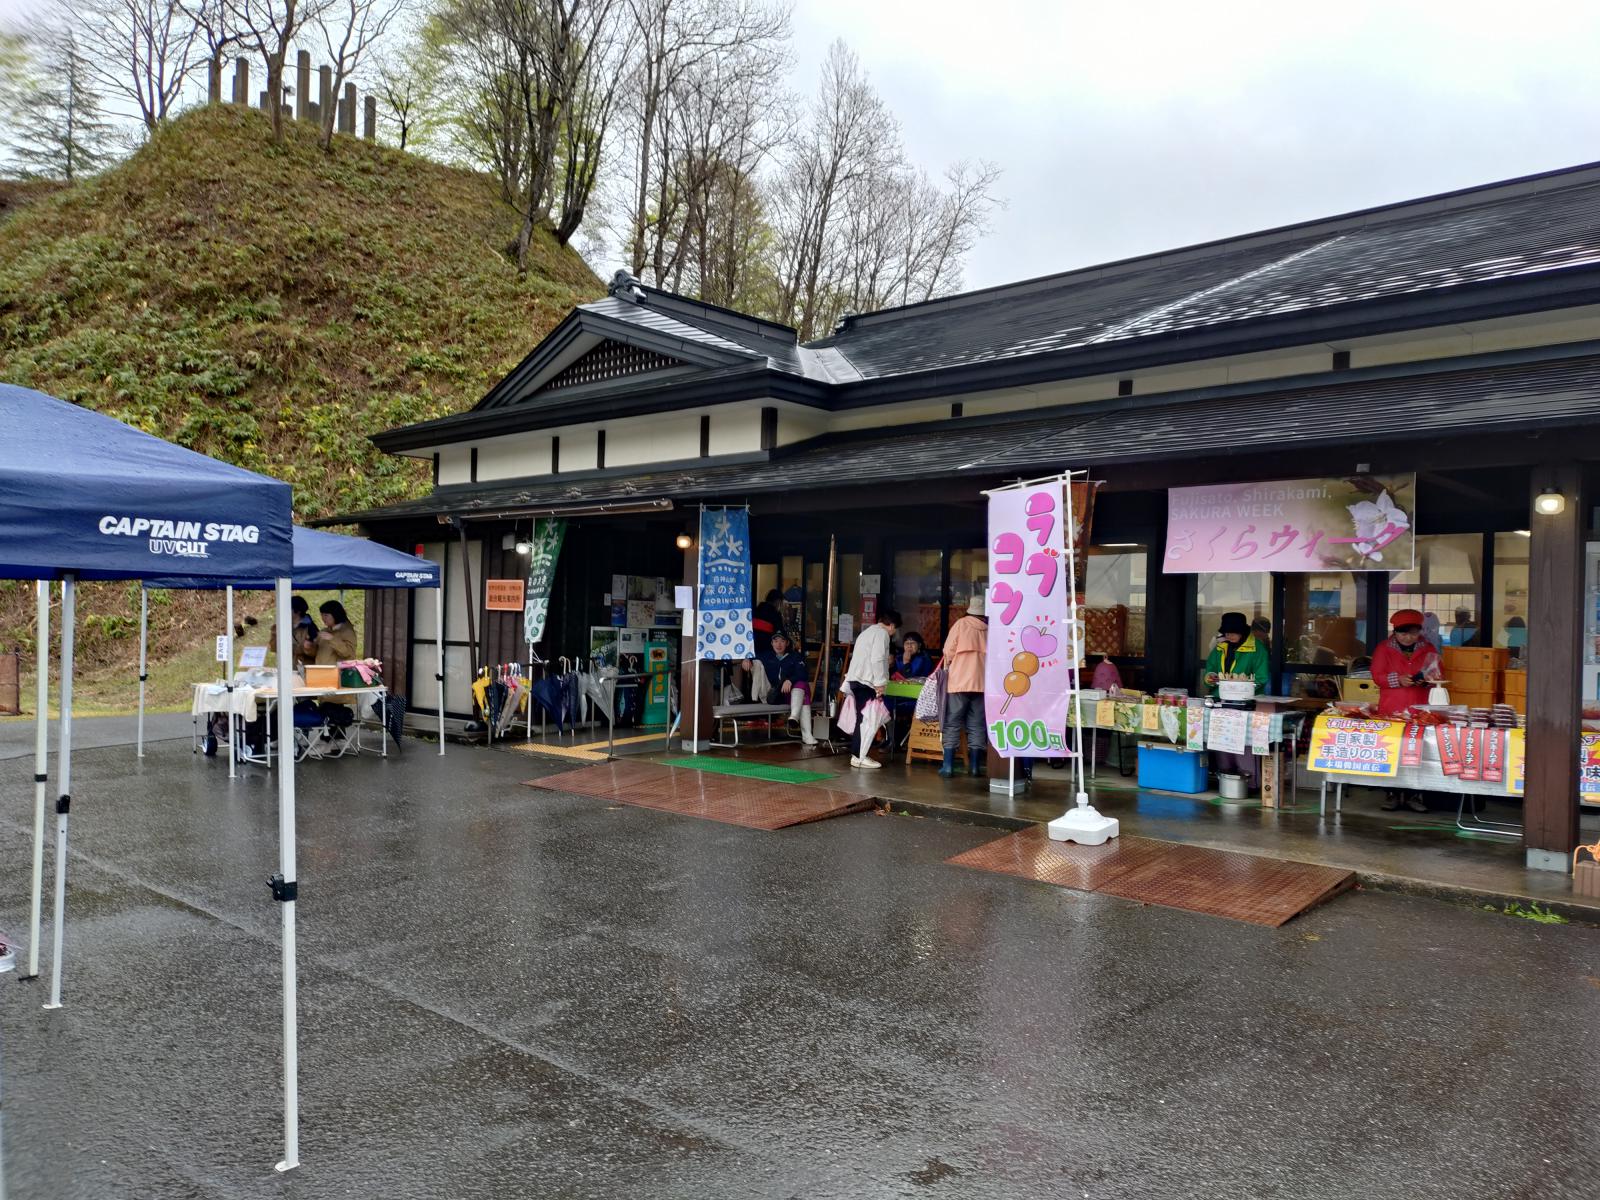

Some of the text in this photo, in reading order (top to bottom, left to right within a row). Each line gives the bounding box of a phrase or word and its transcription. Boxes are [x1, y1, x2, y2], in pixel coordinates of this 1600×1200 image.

[1170, 503, 1286, 521] SAKURA WEEK
[98, 515, 260, 544] CAPTAIN STAG
[1167, 521, 1411, 561] さくらウィーク
[704, 583, 746, 595] 森のえき
[703, 597, 747, 606] MORINOEKI
[990, 719, 1066, 751] 100円
[1336, 732, 1377, 746] 自家製
[1322, 745, 1388, 761] 手造りの味
